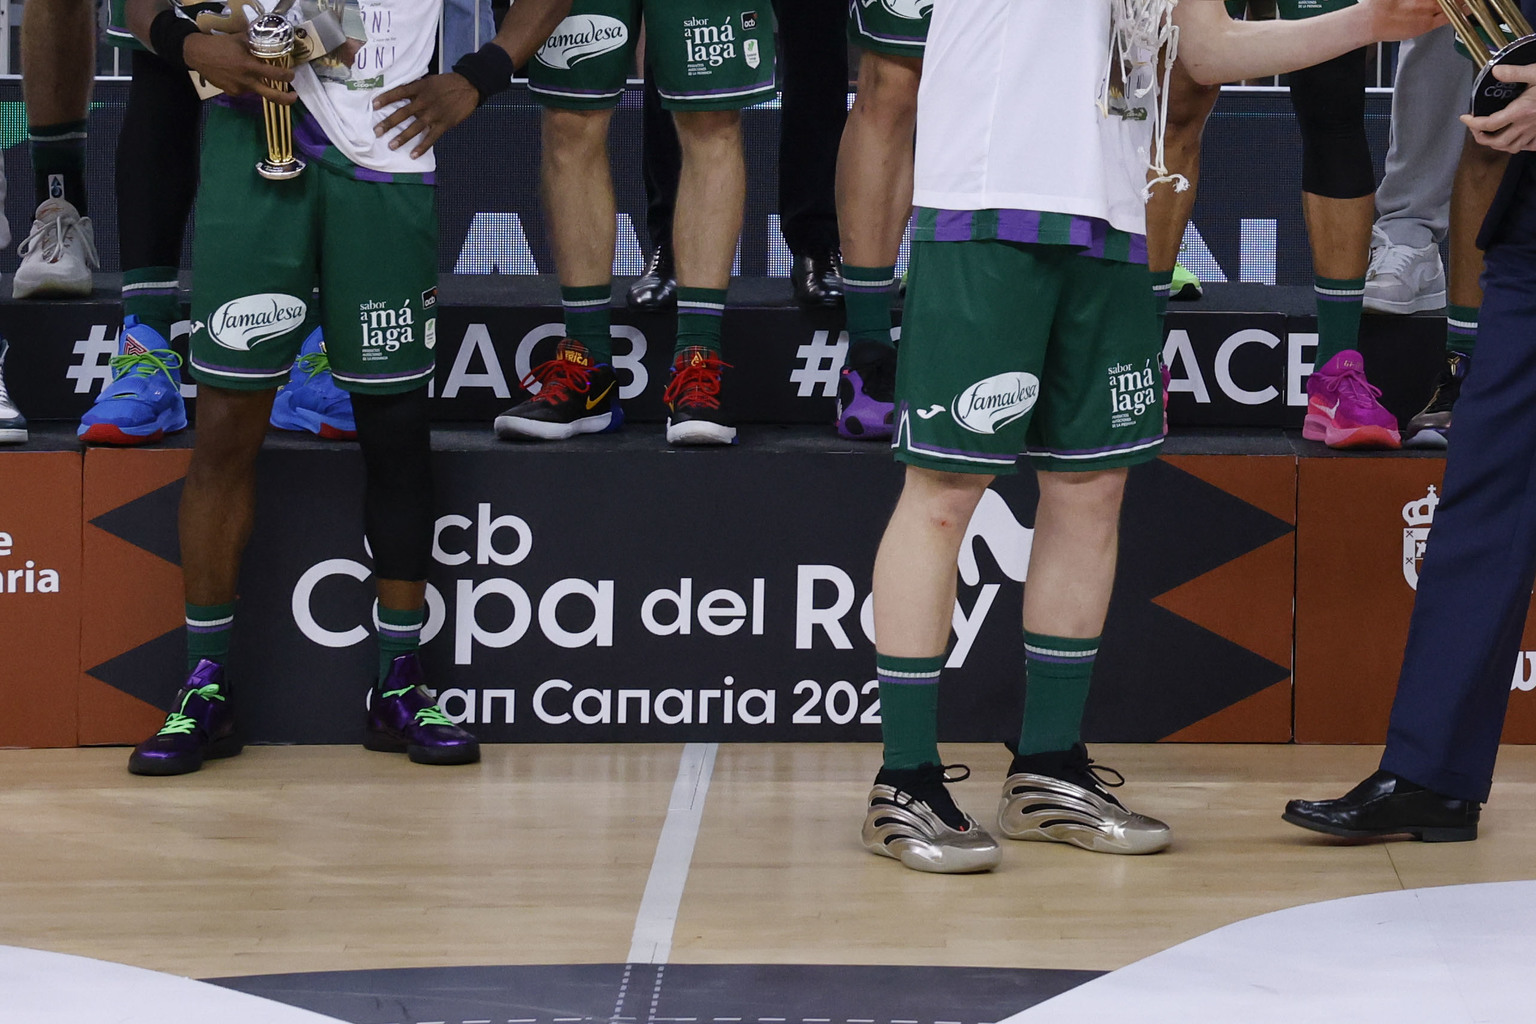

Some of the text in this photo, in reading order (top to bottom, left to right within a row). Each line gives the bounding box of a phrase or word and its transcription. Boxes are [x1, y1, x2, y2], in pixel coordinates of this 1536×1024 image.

[683, 17, 709, 27] sabor
[684, 16, 735, 44] a má
[685, 39, 737, 67] laga
[217, 301, 303, 332] famadesa
[360, 299, 387, 310] sabor
[360, 299, 414, 328] a má
[361, 322, 415, 352] laga
[1108, 362, 1132, 375] sabor
[1109, 358, 1155, 393] a má
[964, 381, 1037, 423] famadesa
[1110, 387, 1156, 416] laga
[640, 578, 765, 636] del
[796, 564, 1001, 668] Ry
[532, 679, 776, 725] Canaria
[792, 679, 882, 725] 202
